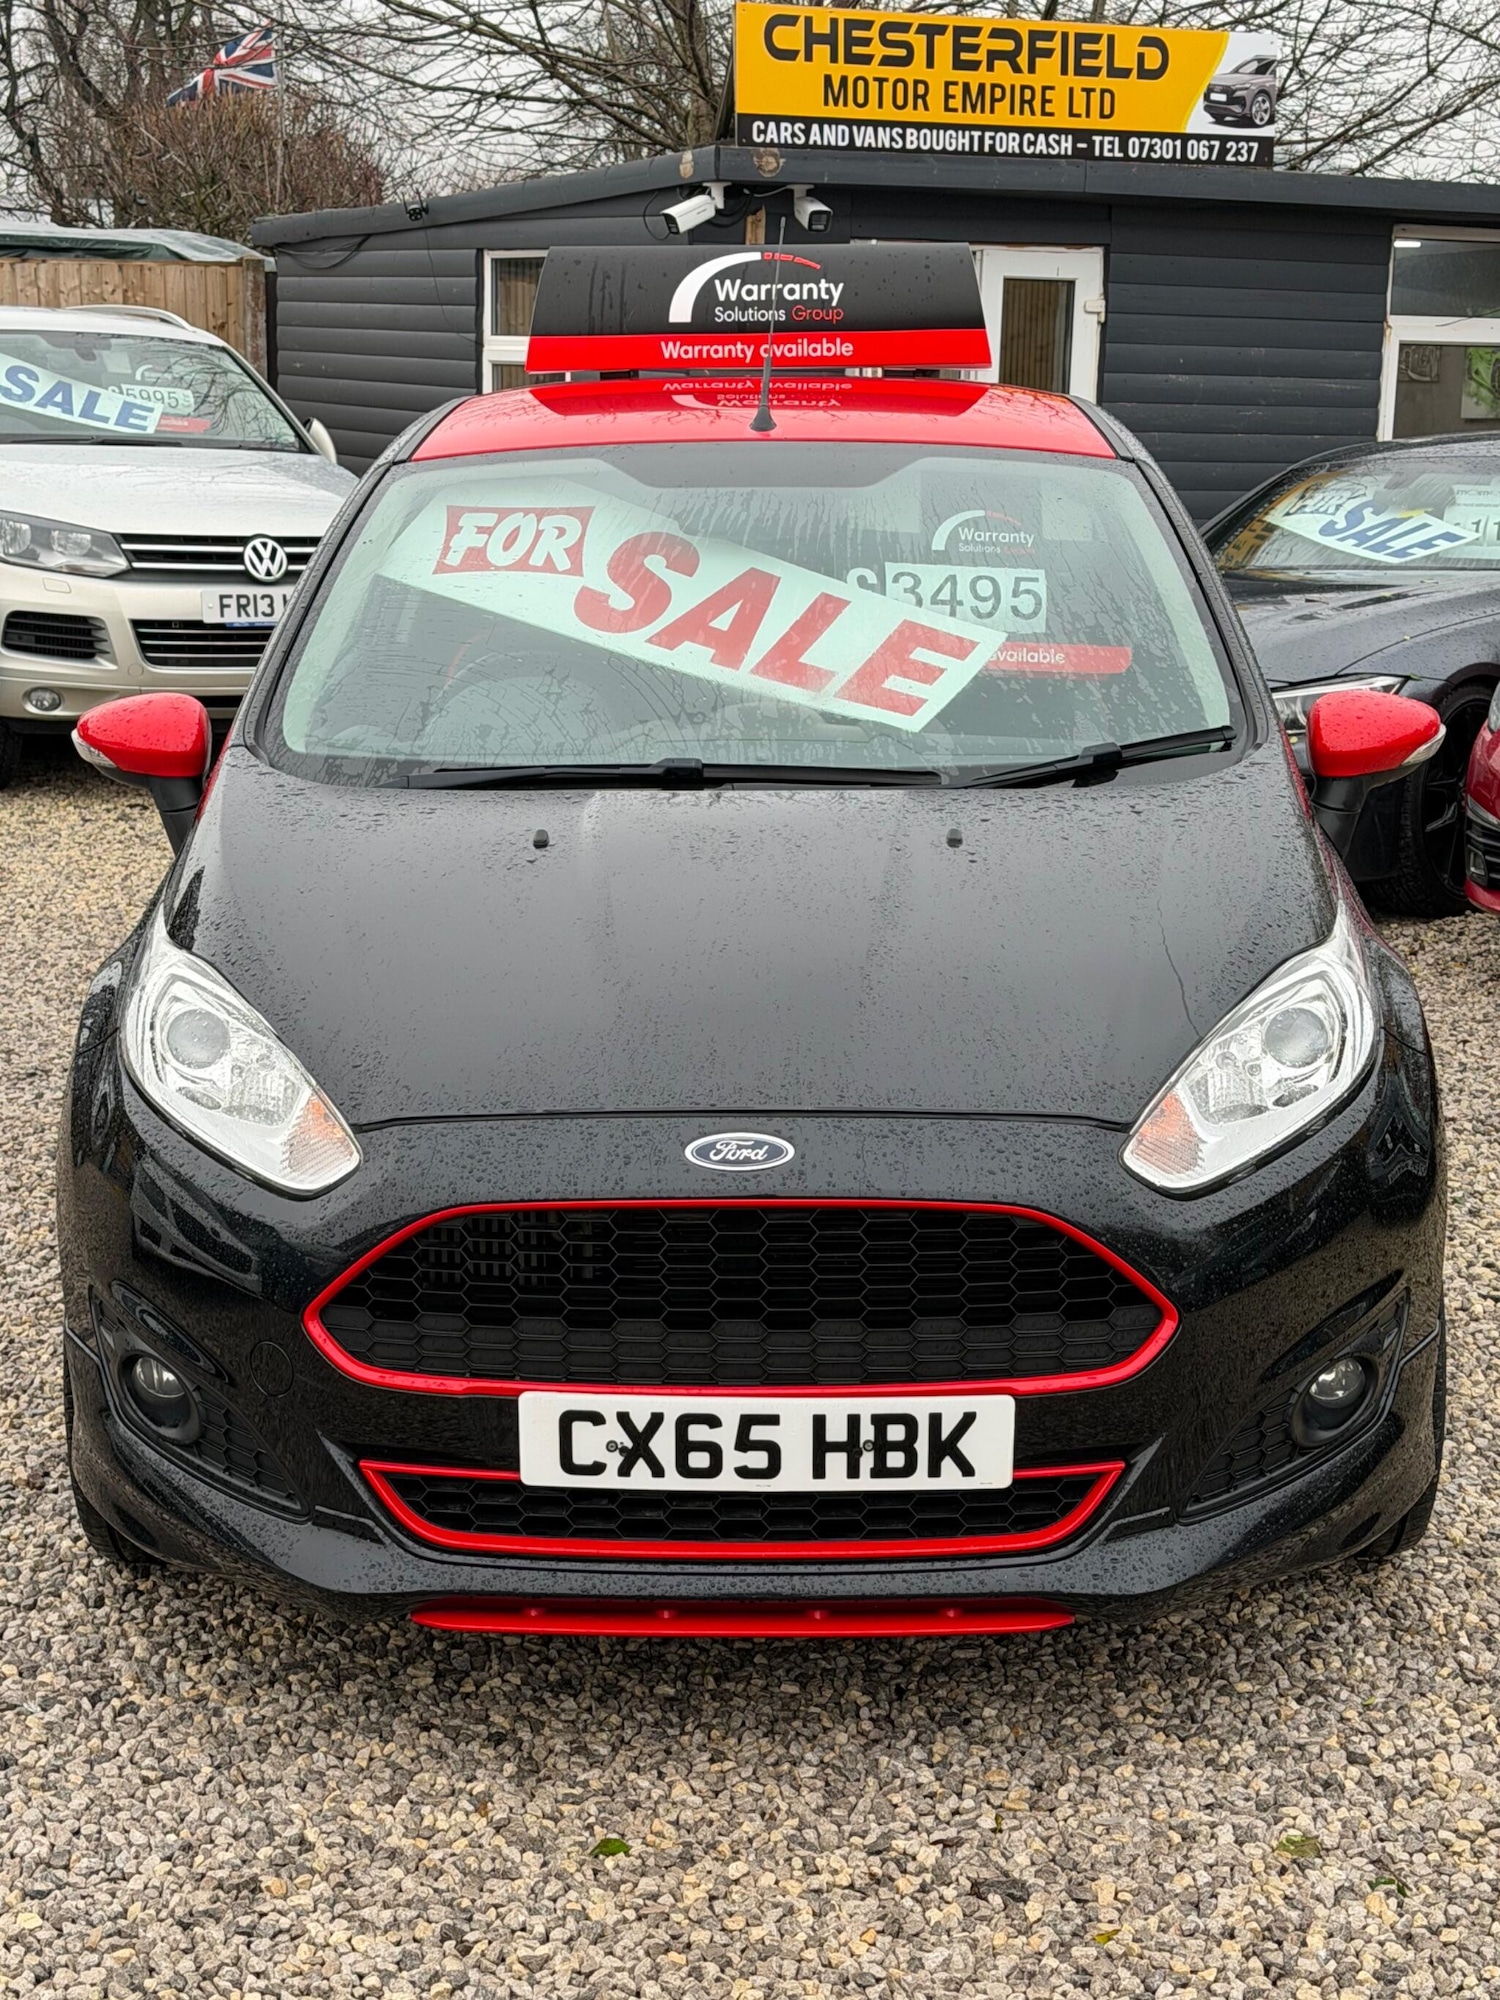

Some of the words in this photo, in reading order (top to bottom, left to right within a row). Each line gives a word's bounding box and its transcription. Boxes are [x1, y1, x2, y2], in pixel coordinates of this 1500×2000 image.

[763, 13, 1170, 81] CHESTERFIELD
[823, 74, 929, 111] MOTOR
[944, 80, 1056, 117] EMPIRE
[1068, 86, 1115, 119] LTD
[752, 121, 805, 144] CARS
[809, 124, 849, 147] AND
[852, 126, 904, 149] VANS
[906, 128, 982, 152] BOUGHT
[984, 131, 1020, 154] FOR
[1023, 133, 1072, 156] CASH
[1092, 135, 1124, 158] TEL
[1128, 137, 1182, 160] 07301
[1187, 140, 1220, 161] 067
[1226, 141, 1259, 162] 237
[714, 278, 844, 307] Warranty
[714, 306, 786, 322] Solutions
[791, 305, 844, 324] Group
[660, 341, 754, 364] Warranty
[759, 338, 854, 358] available
[0, 365, 154, 432] SALE
[108, 386, 180, 409] 5995
[445, 508, 576, 573] FOR
[958, 527, 1034, 547] Warranty
[1318, 500, 1467, 558] SALE
[219, 593, 275, 618] FR13
[574, 531, 981, 717] SALE
[709, 1140, 769, 1161] Ford
[558, 1409, 782, 1480] CX65
[812, 1411, 978, 1480] HBK
